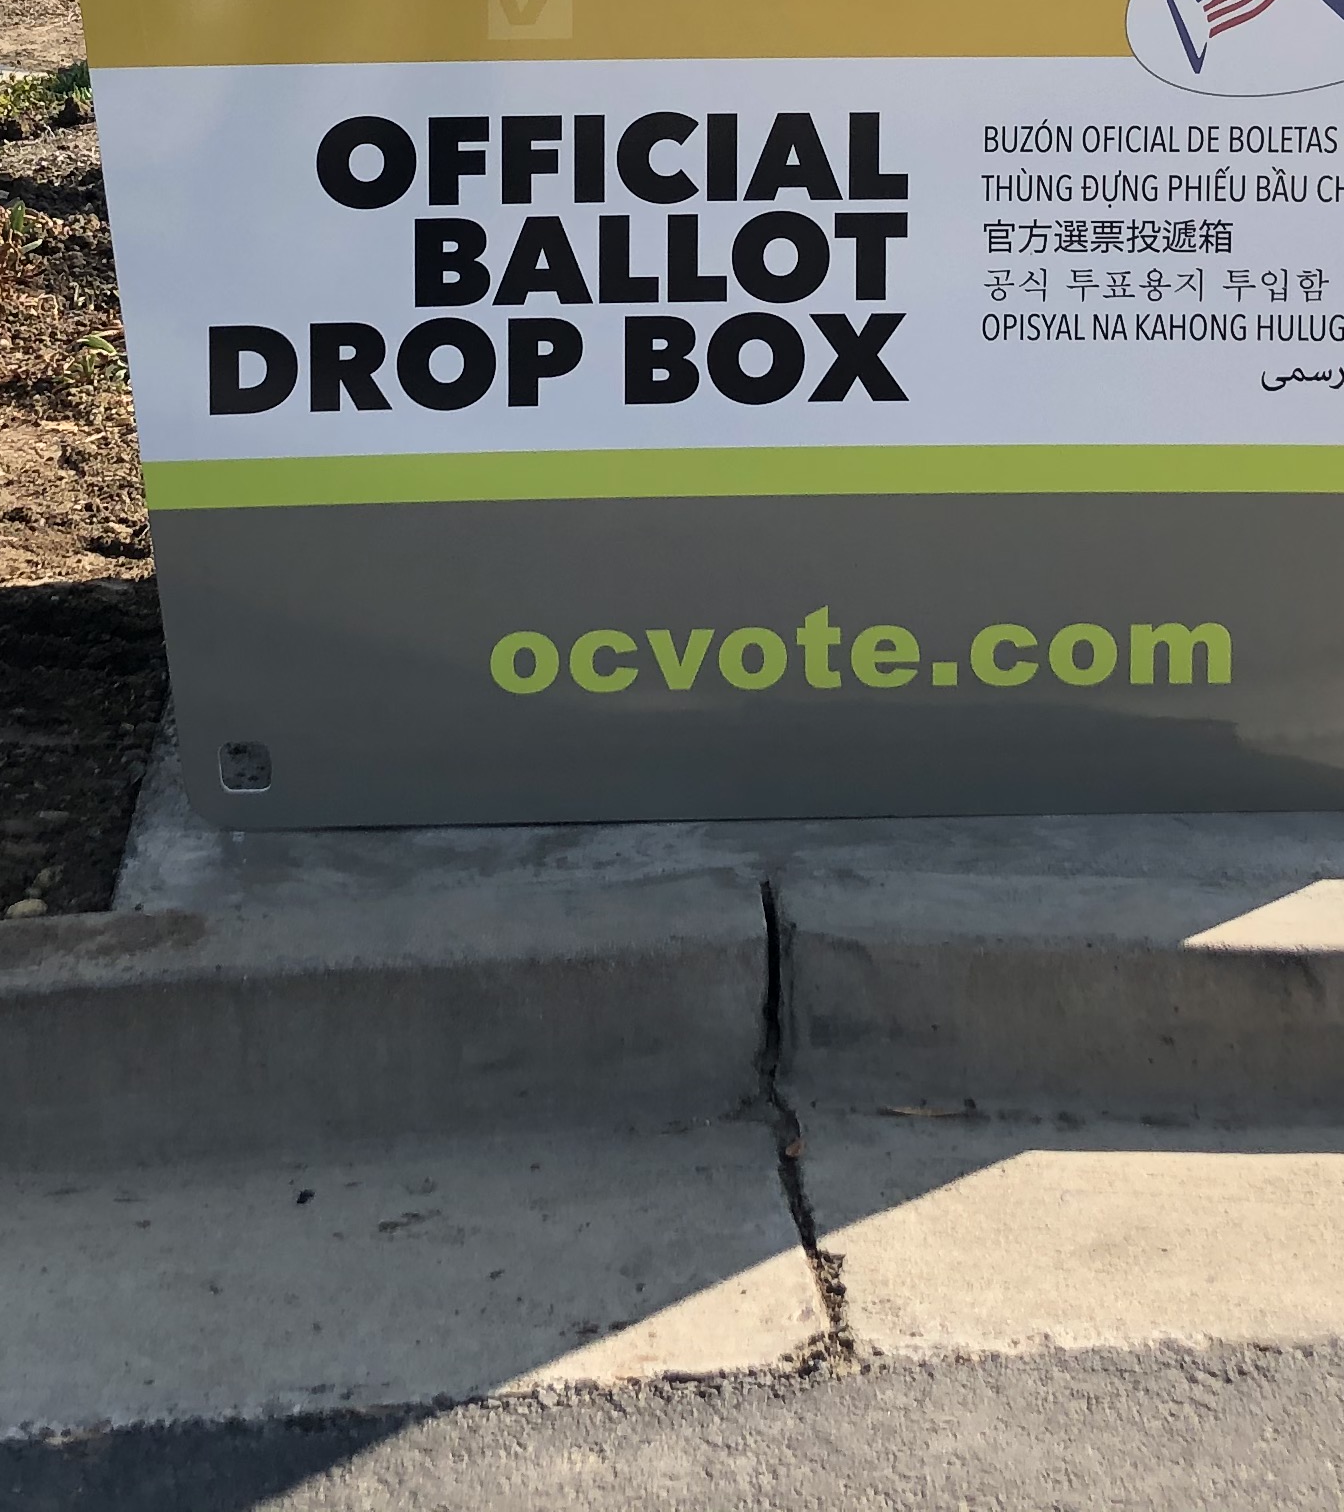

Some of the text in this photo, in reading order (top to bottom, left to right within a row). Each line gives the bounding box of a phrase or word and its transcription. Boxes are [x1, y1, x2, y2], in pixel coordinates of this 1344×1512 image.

[985, 119, 1072, 153] BUZÓN
[1083, 126, 1181, 153] OFICIAL
[1188, 126, 1220, 152] DE
[1230, 126, 1338, 153] BOLETAS
[317, 111, 909, 210] OFFICIAL
[982, 167, 1073, 202] THÙNG
[1081, 170, 1158, 208] ĐỰNG
[1169, 166, 1246, 202] PHIẾU
[1257, 167, 1308, 203] BẦU
[983, 219, 1234, 254] 官方選票投遞箱
[414, 210, 909, 307] BALLOT
[983, 268, 1330, 302] 공식 투표용지 투입함
[982, 314, 1085, 341] OPISYAL
[1093, 314, 1127, 341] NA
[1135, 314, 1247, 342] KAHONG
[209, 312, 910, 415] DROP BOX
[489, 604, 1234, 694] ocvote.com
